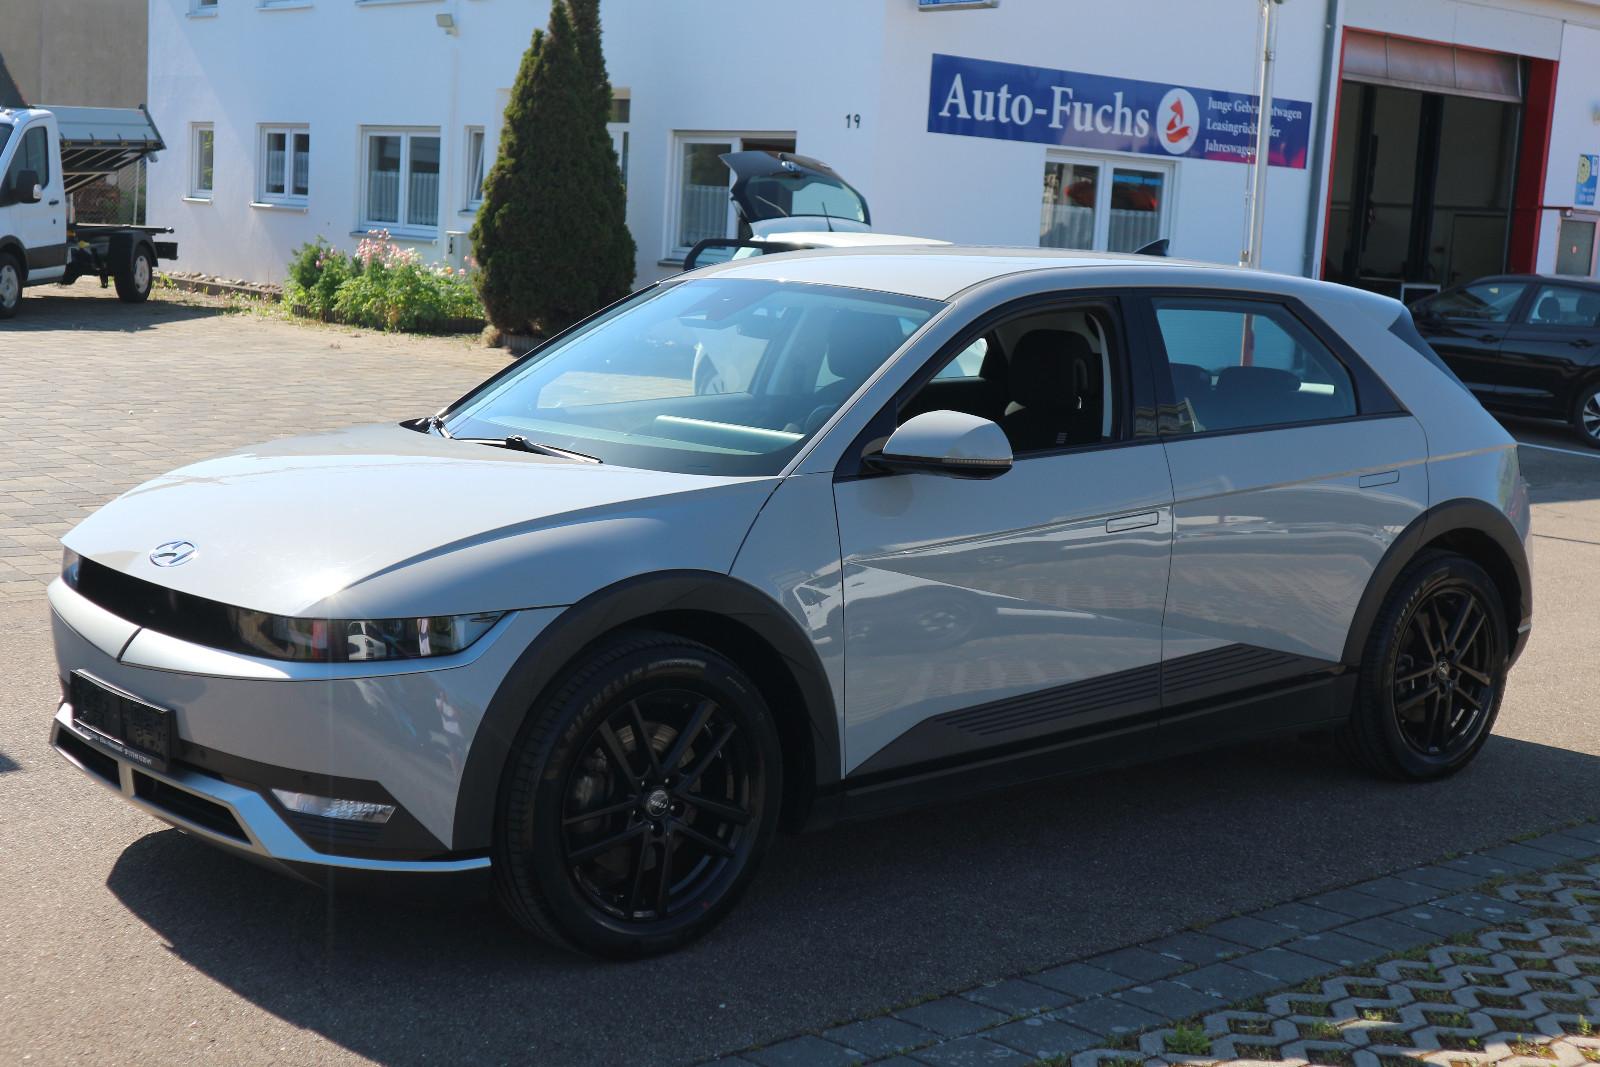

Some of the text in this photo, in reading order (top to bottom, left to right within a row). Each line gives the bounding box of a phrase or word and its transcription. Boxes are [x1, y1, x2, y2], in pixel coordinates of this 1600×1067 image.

[939, 73, 1149, 137] Auto-Fuchs
[1208, 97, 1232, 114] Junge
[845, 113, 861, 128] 19
[1205, 139, 1256, 158] Jahreswagen
